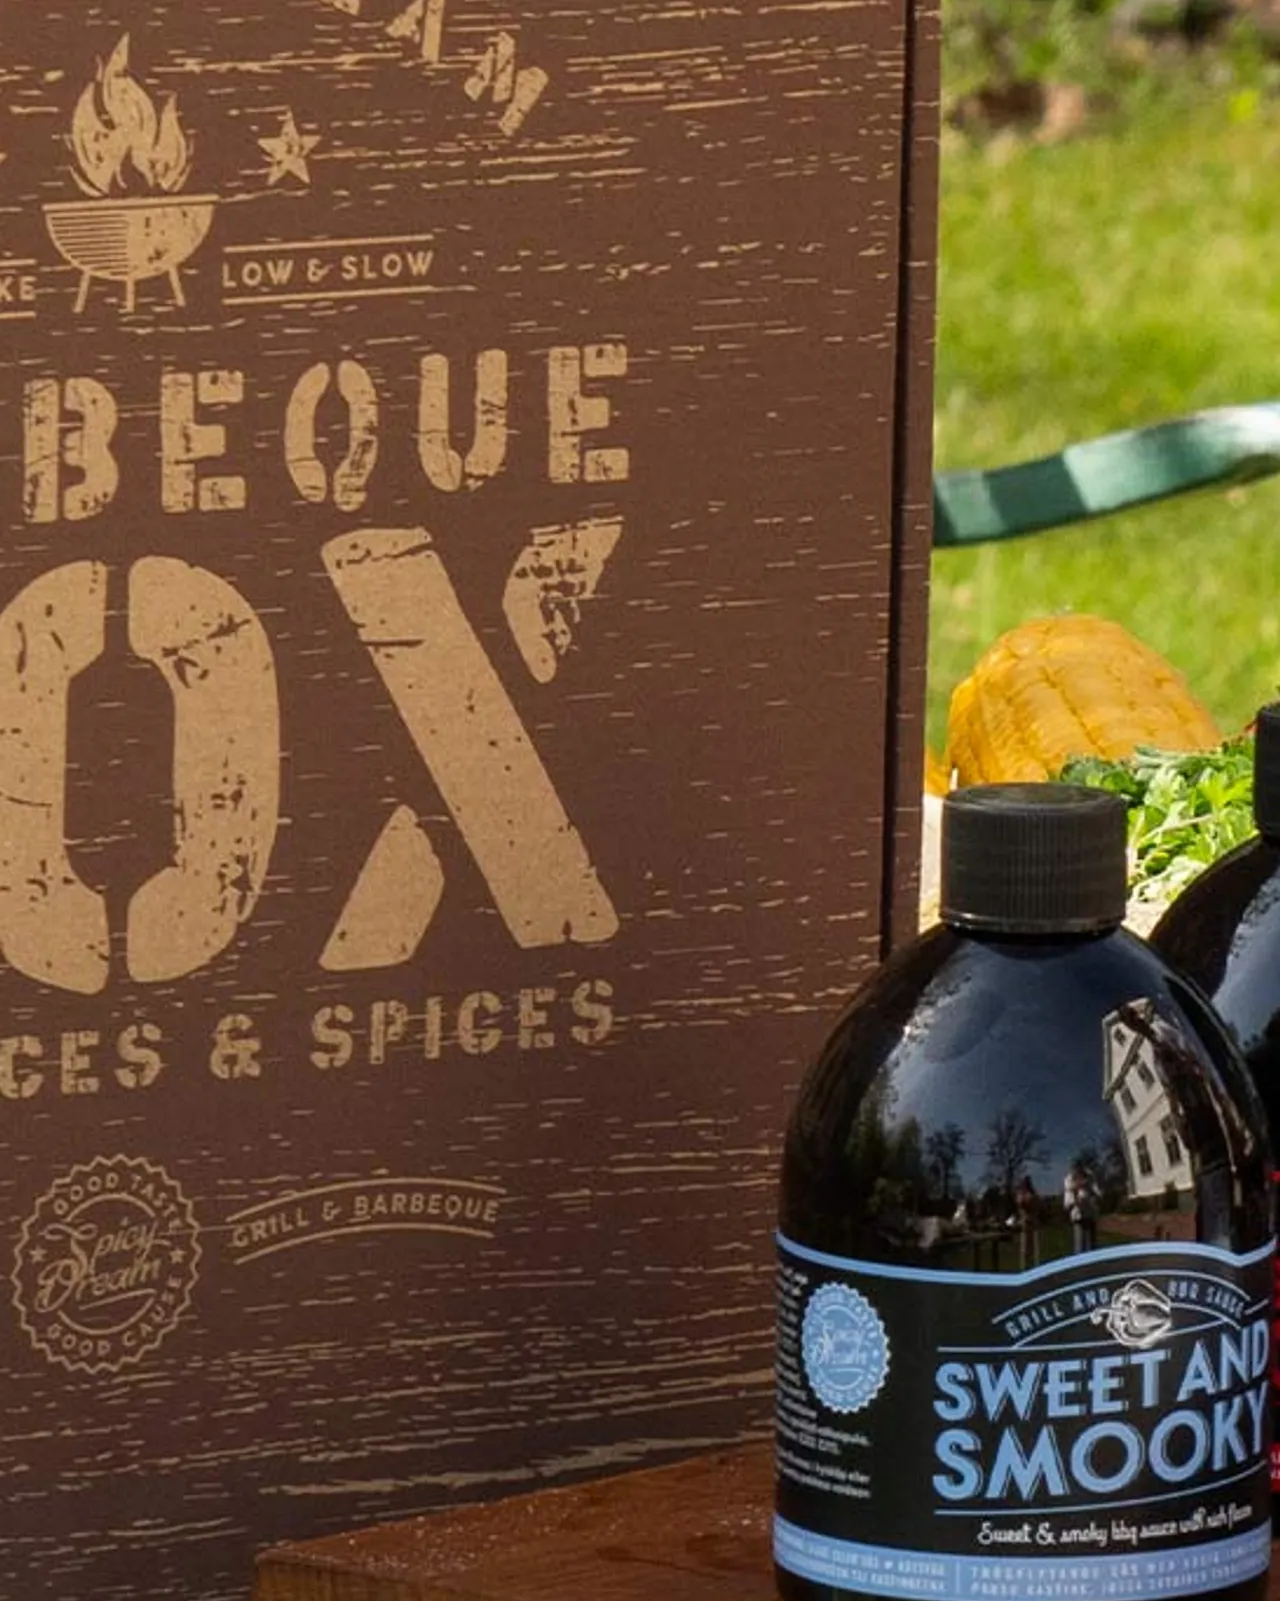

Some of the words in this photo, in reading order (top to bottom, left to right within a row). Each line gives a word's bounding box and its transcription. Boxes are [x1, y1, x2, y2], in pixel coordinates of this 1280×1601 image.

[222, 256, 297, 289] LOW
[307, 255, 332, 284] &
[340, 249, 434, 282] SLOW
[208, 1012, 263, 1081] &
[310, 979, 615, 1069] SPICES
[53, 1172, 119, 1216] GOOD
[232, 1206, 310, 1249] GRILL
[321, 1199, 346, 1222] &
[353, 1194, 500, 1223] BARBEQUE
[1005, 1303, 1067, 1339] GRILL
[1073, 1288, 1109, 1311] AND
[47, 1323, 111, 1356] GOOD
[933, 1348, 1171, 1422] SWEET
[1176, 1319, 1269, 1405] AND
[932, 1380, 1269, 1501] SMOOKY
[977, 1521, 1032, 1545] Sweet
[1059, 1520, 1108, 1547] smoky
[1111, 1520, 1138, 1546] bbq
